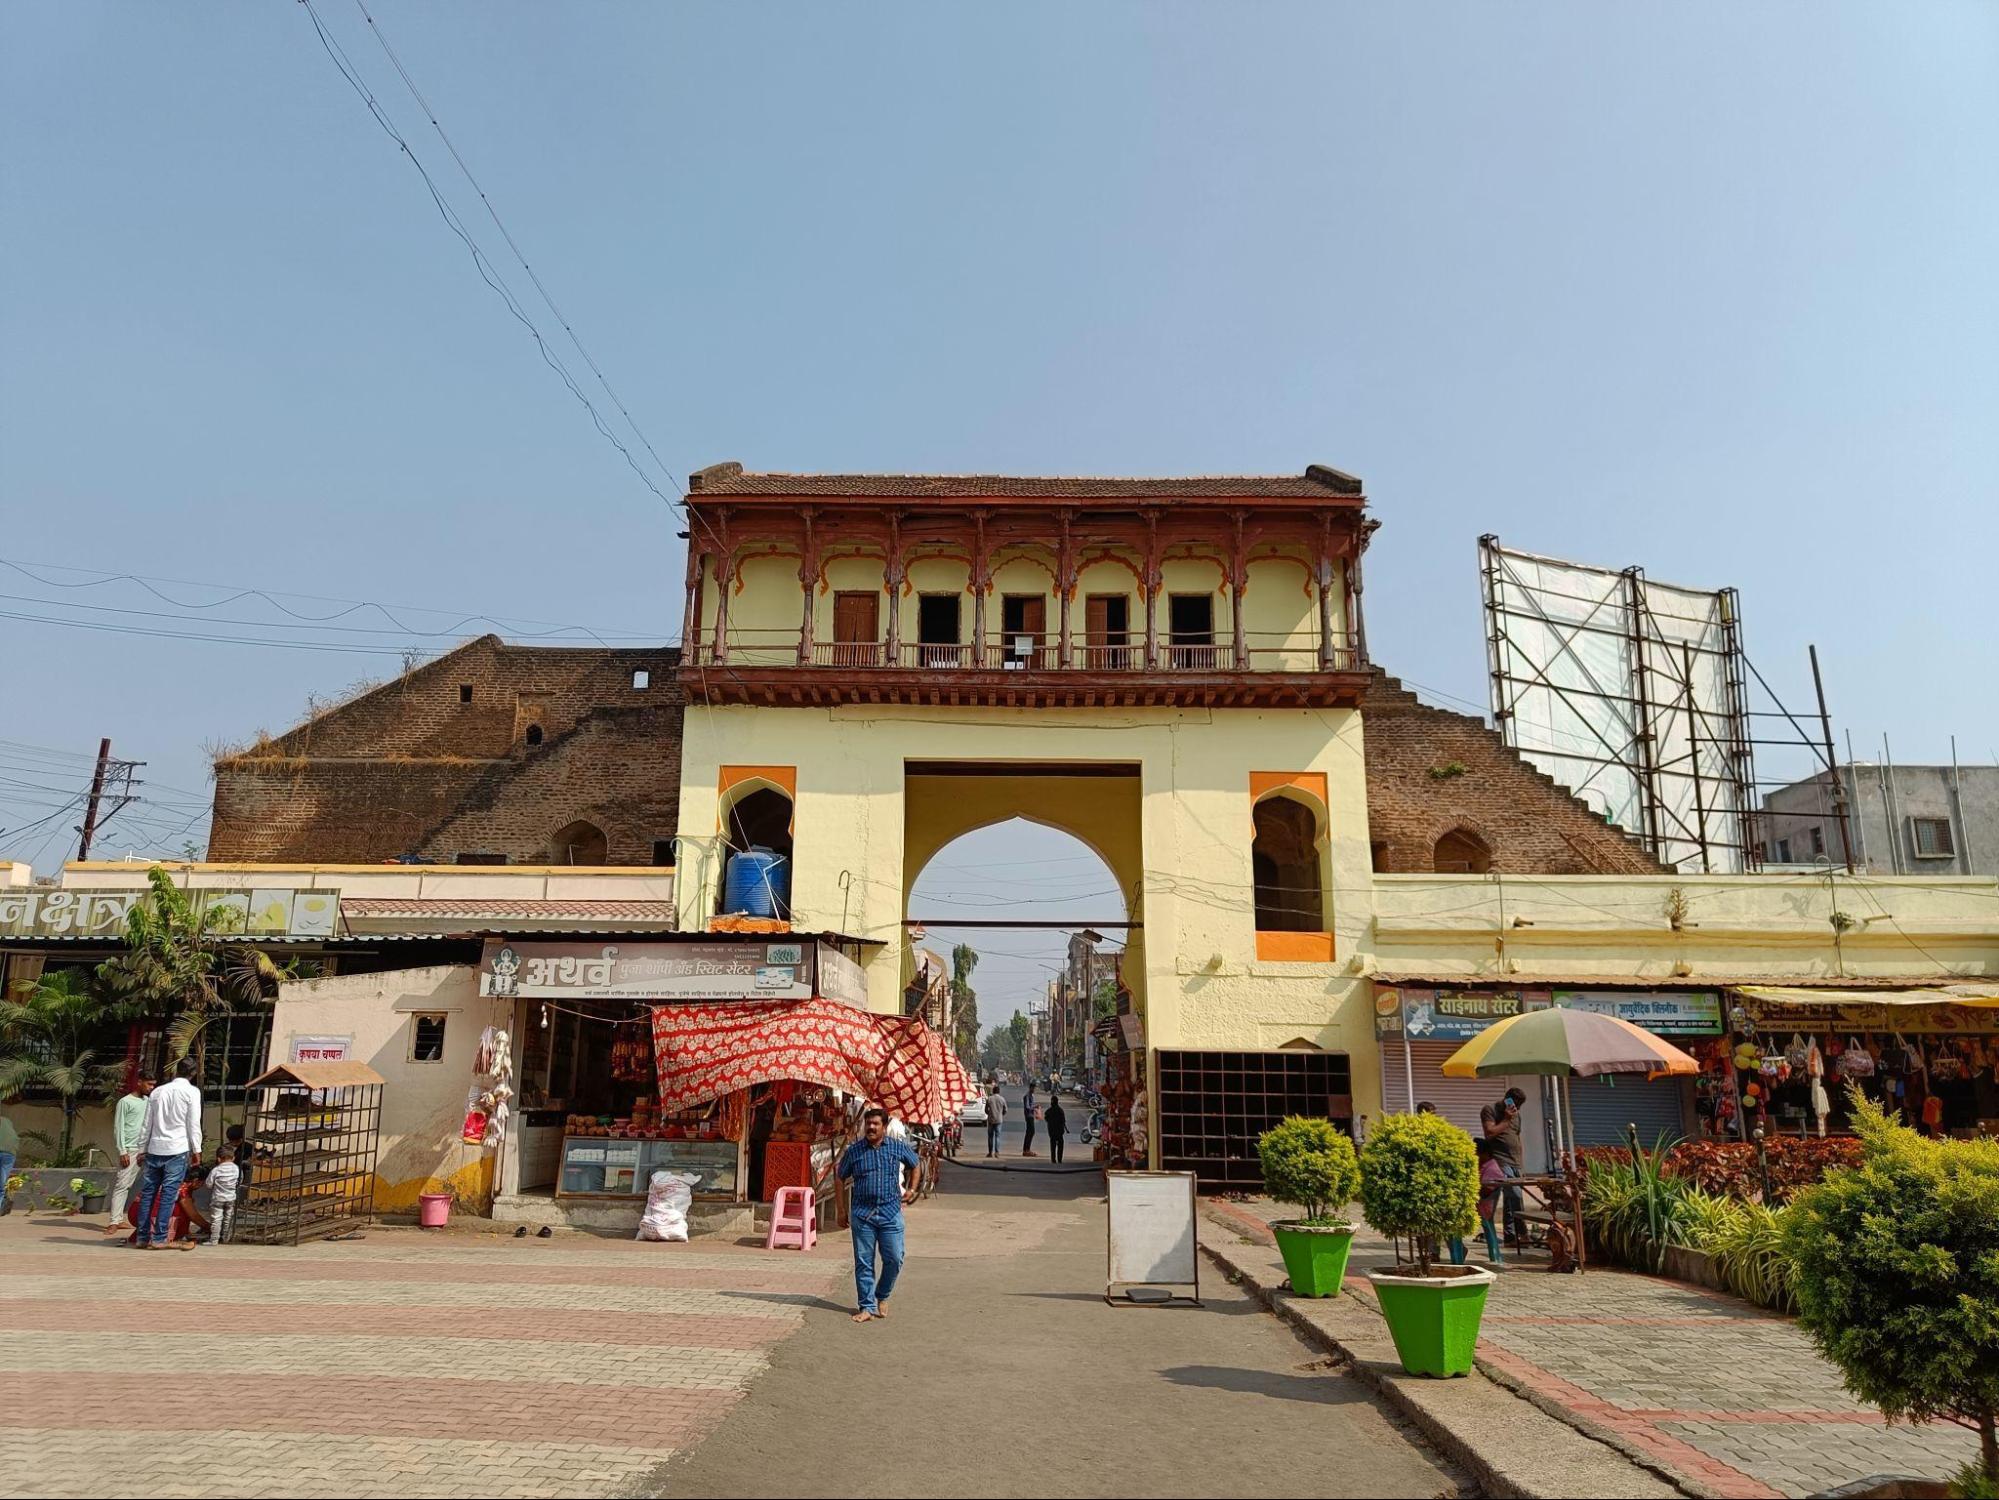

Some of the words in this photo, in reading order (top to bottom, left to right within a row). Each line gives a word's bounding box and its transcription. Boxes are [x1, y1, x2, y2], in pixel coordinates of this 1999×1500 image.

[0, 892, 143, 932] नक्षत्र
[526, 946, 619, 987] अथर्व
[726, 960, 753, 975] सेंटर
[1439, 993, 1487, 1015] साईनाथ
[1491, 994, 1519, 1014] सेंटर
[299, 1049, 320, 1062] कृपया
[322, 1049, 343, 1060] चप्पल
